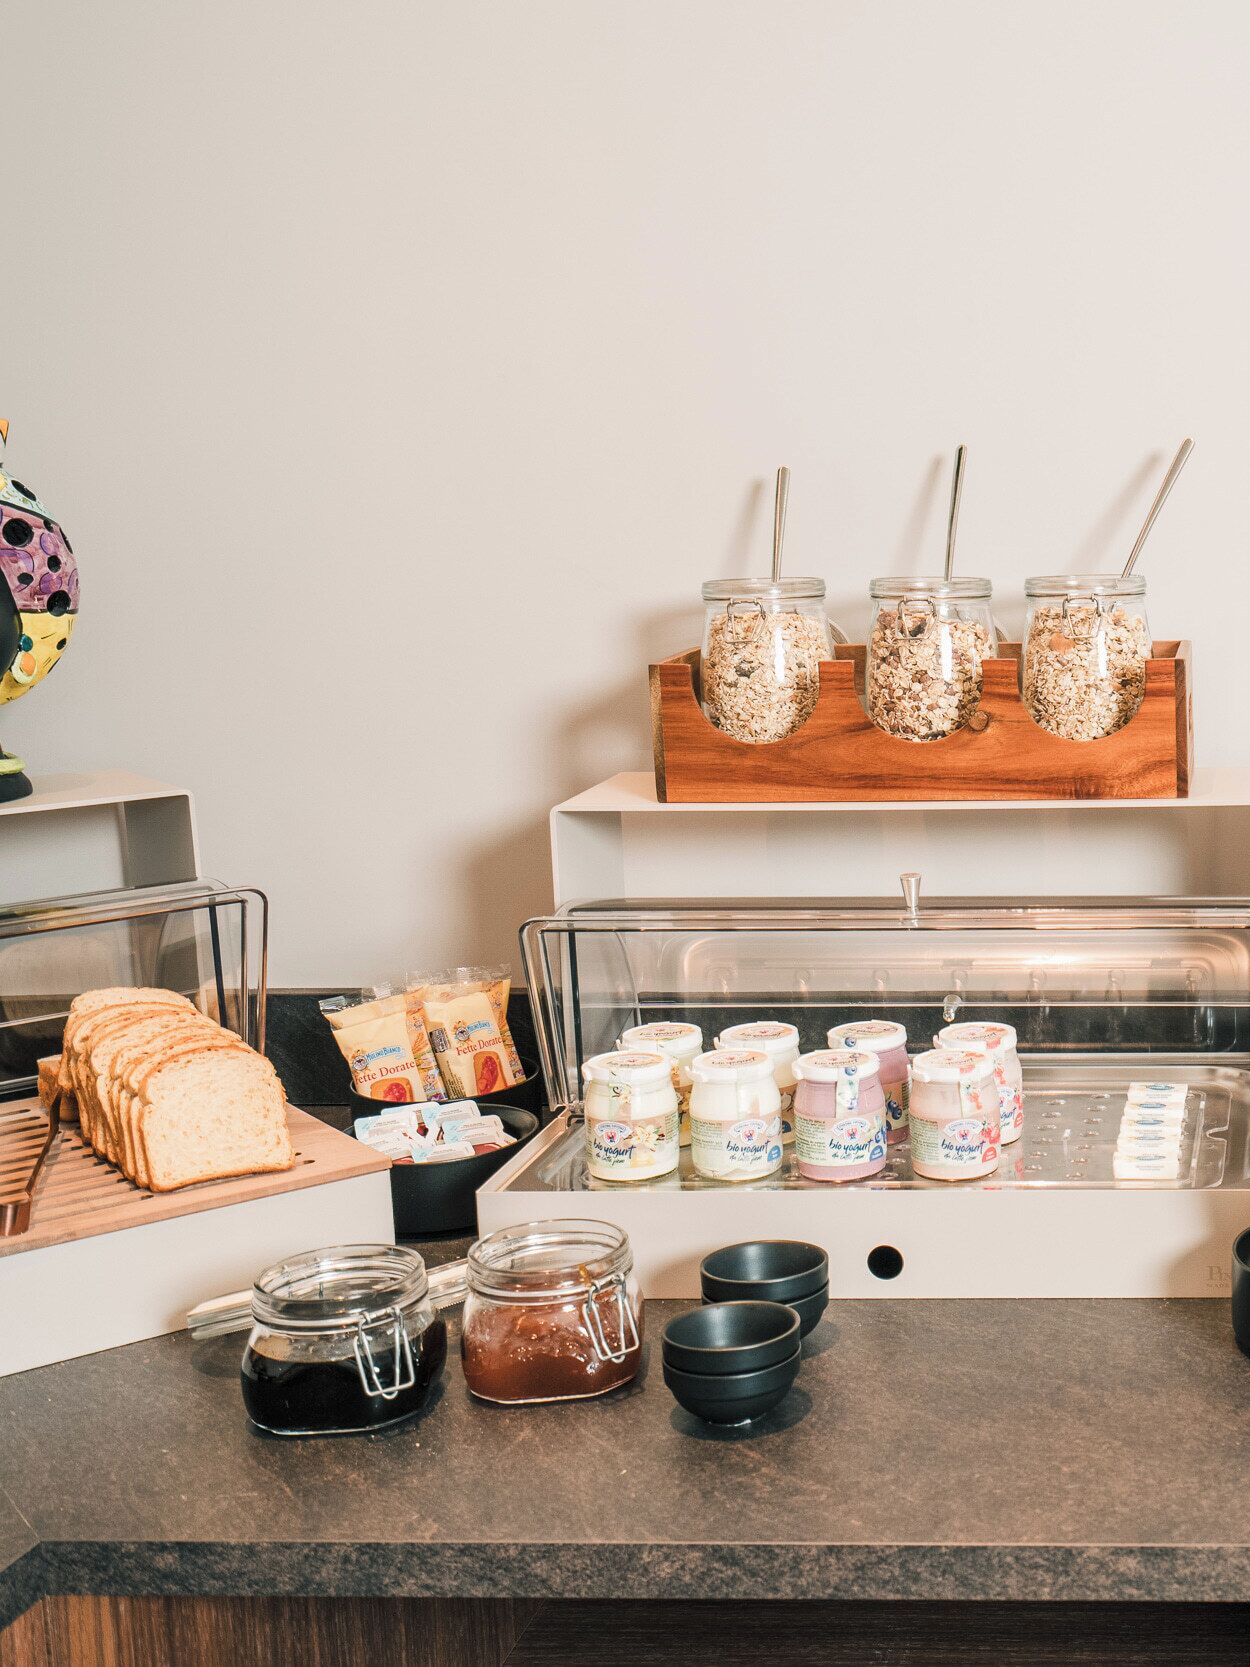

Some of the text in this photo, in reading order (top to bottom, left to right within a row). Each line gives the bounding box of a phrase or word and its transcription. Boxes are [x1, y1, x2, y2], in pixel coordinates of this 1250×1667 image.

[456, 1036, 503, 1056] Fette Dorate
[379, 1059, 415, 1077] Dorate
[593, 1138, 636, 1160] bio yogurt
[726, 1140, 739, 1152] bio
[740, 1140, 771, 1156] yogurt
[829, 1138, 842, 1150] bio
[843, 1138, 874, 1154] yogurt
[941, 1138, 954, 1151] bio
[955, 1140, 986, 1156] yogurt
